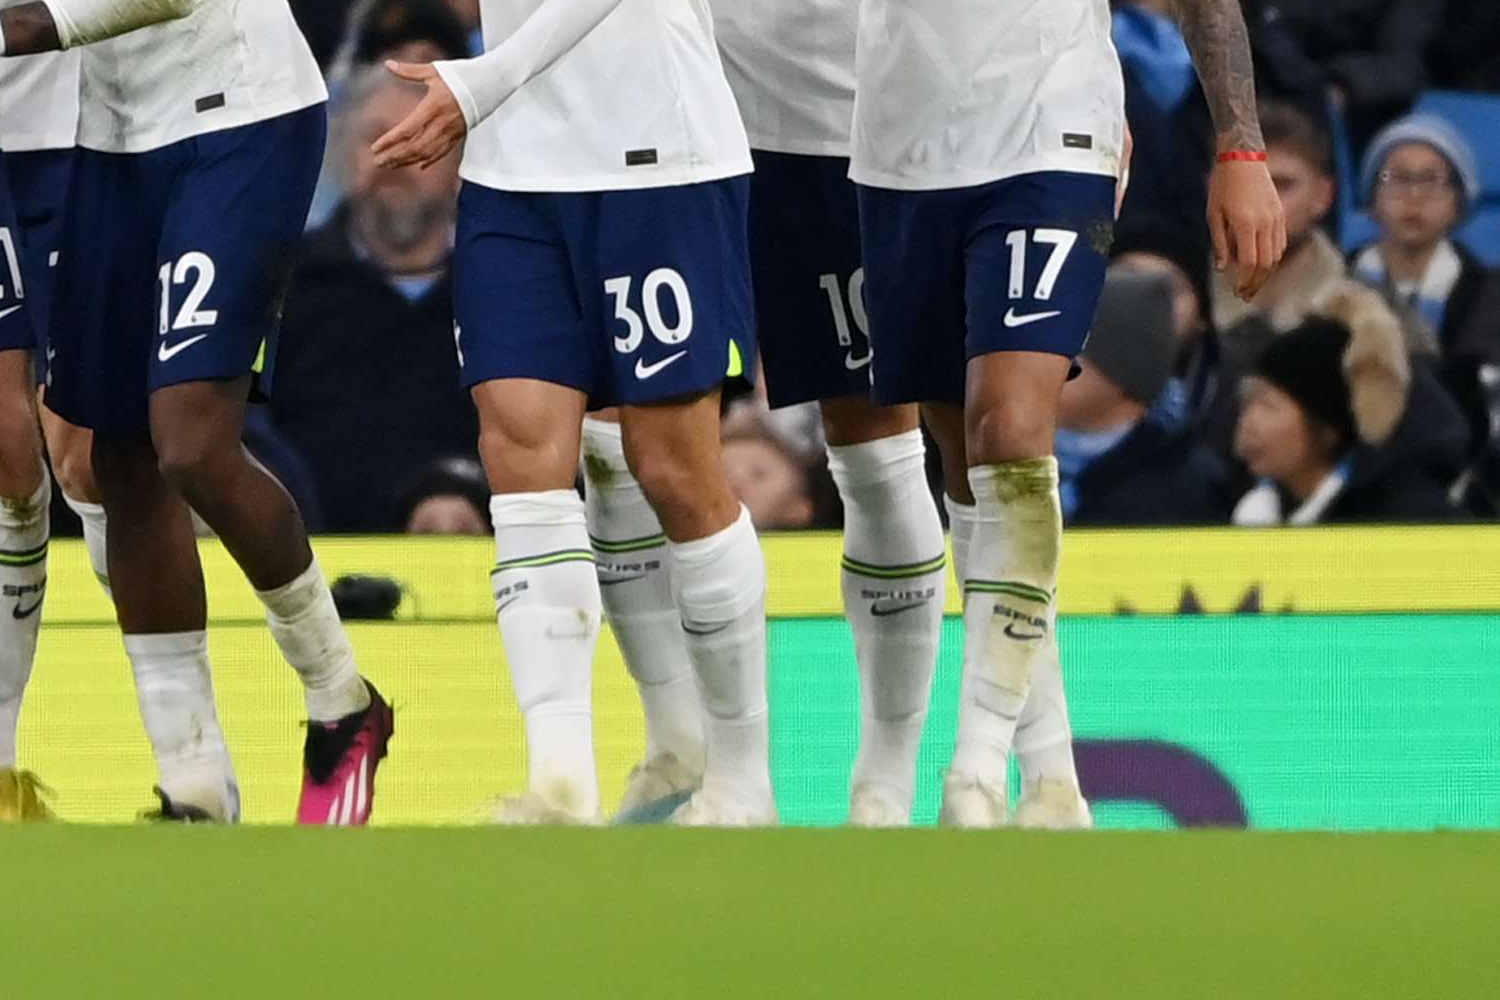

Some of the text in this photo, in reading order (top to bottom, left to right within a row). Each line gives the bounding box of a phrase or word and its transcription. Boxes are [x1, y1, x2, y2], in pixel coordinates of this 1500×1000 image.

[158, 251, 218, 335] 12
[1005, 228, 1078, 299] 17
[604, 268, 694, 353] 30
